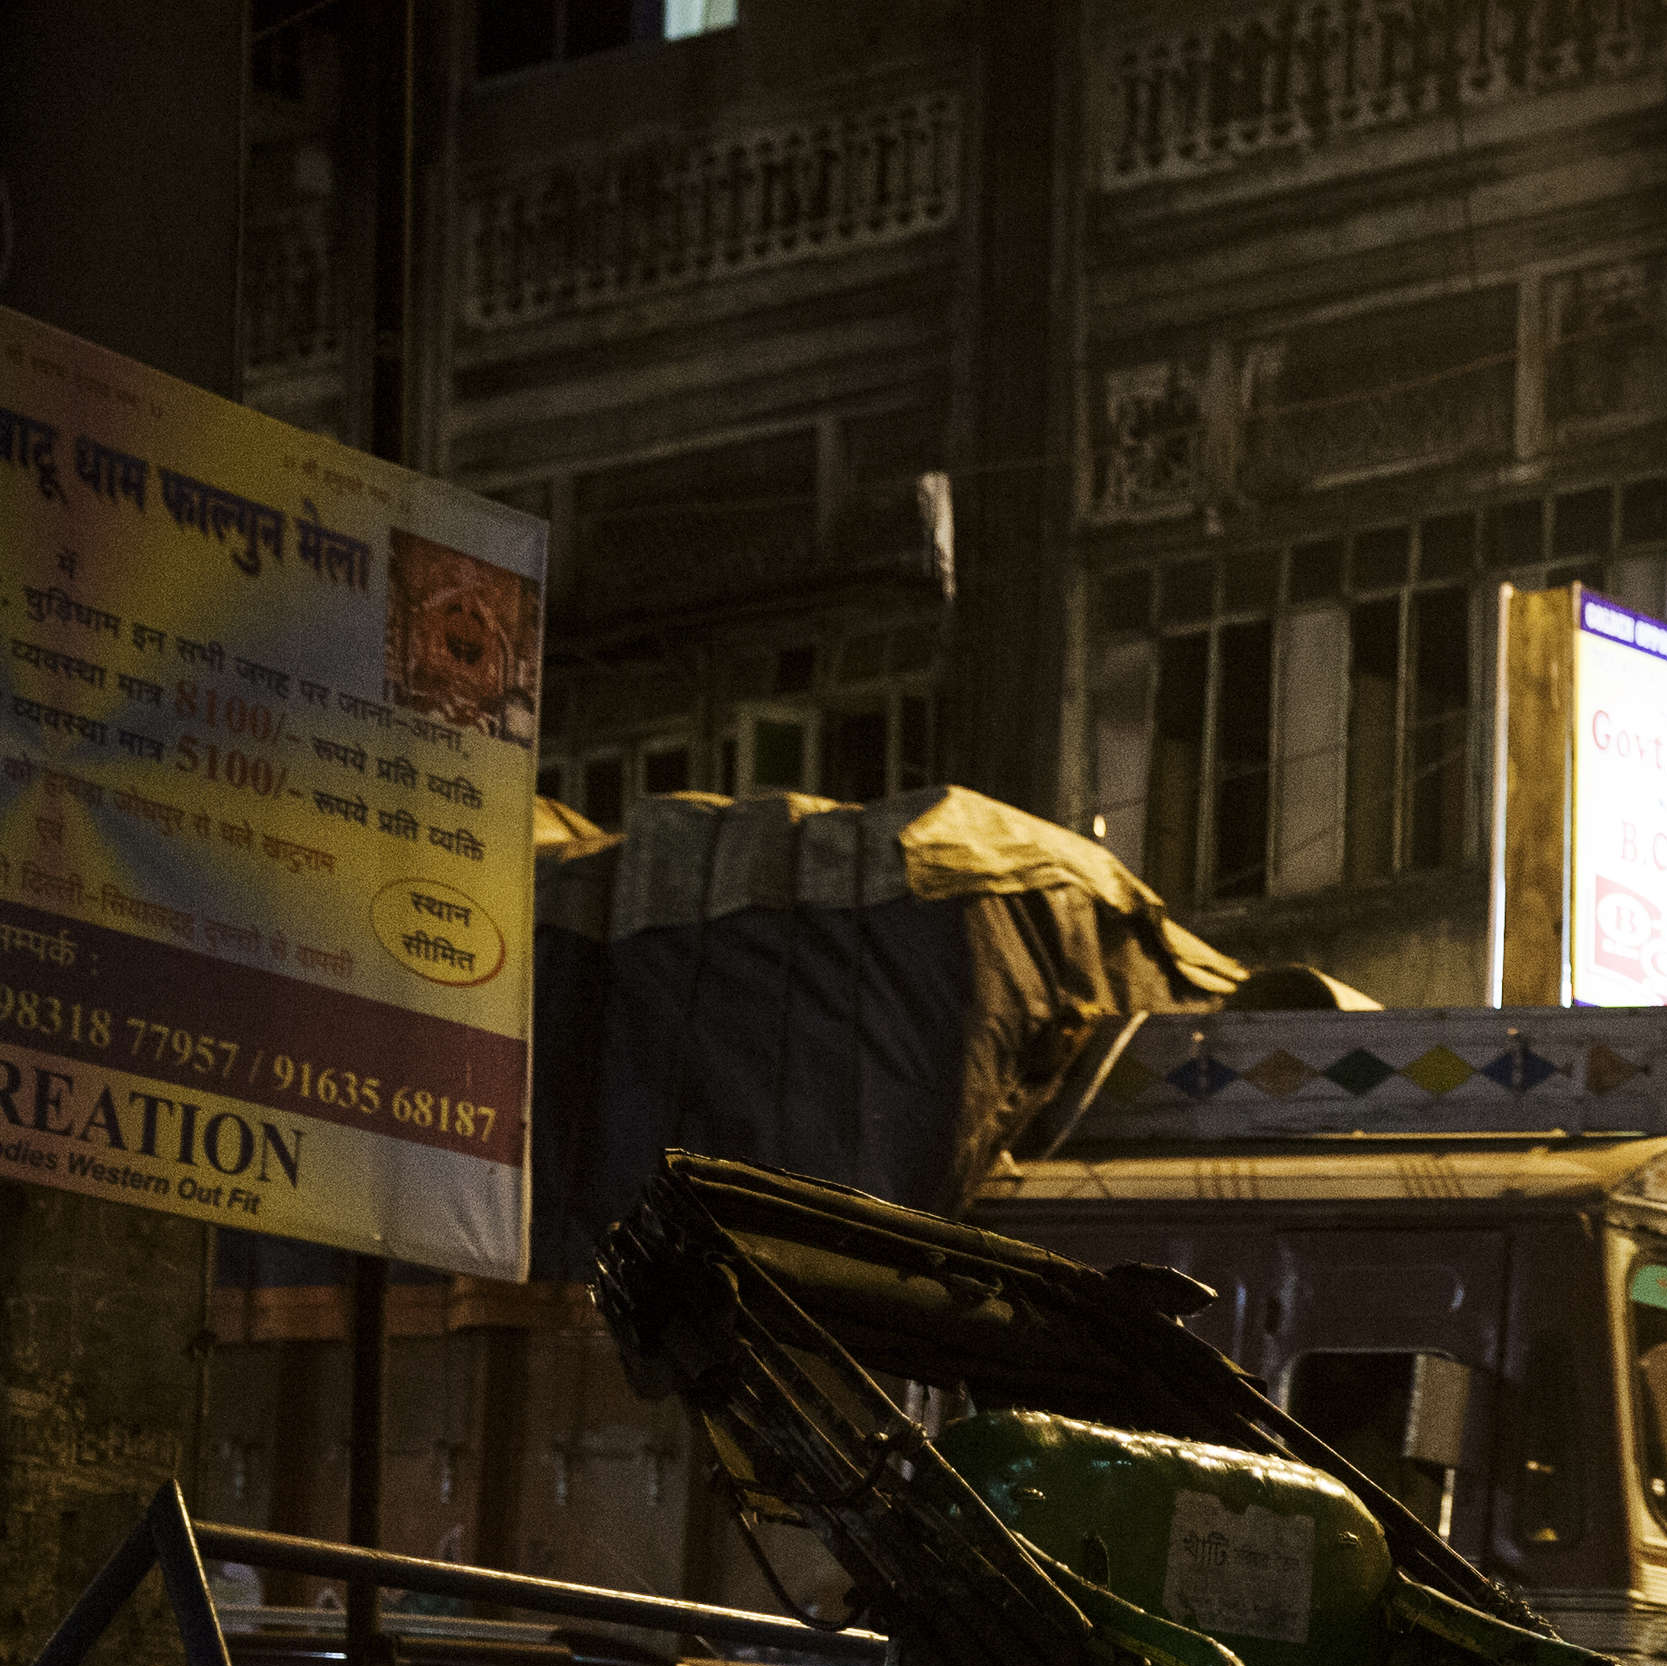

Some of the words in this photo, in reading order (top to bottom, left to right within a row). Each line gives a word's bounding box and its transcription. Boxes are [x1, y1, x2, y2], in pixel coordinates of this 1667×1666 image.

[75, 432, 148, 516] धाम
[157, 465, 286, 578] फाल्गुन
[294, 496, 372, 592] मेला
[410, 888, 473, 929] स्थान
[401, 927, 477, 974] सीमित
[126, 1016, 241, 1079] 77957
[272, 1053, 382, 1116] 91635
[391, 1085, 497, 1144] 68187
[66, 1150, 170, 1197] Western
[176, 1176, 223, 1209] Out
[227, 1187, 263, 1217] Fit
